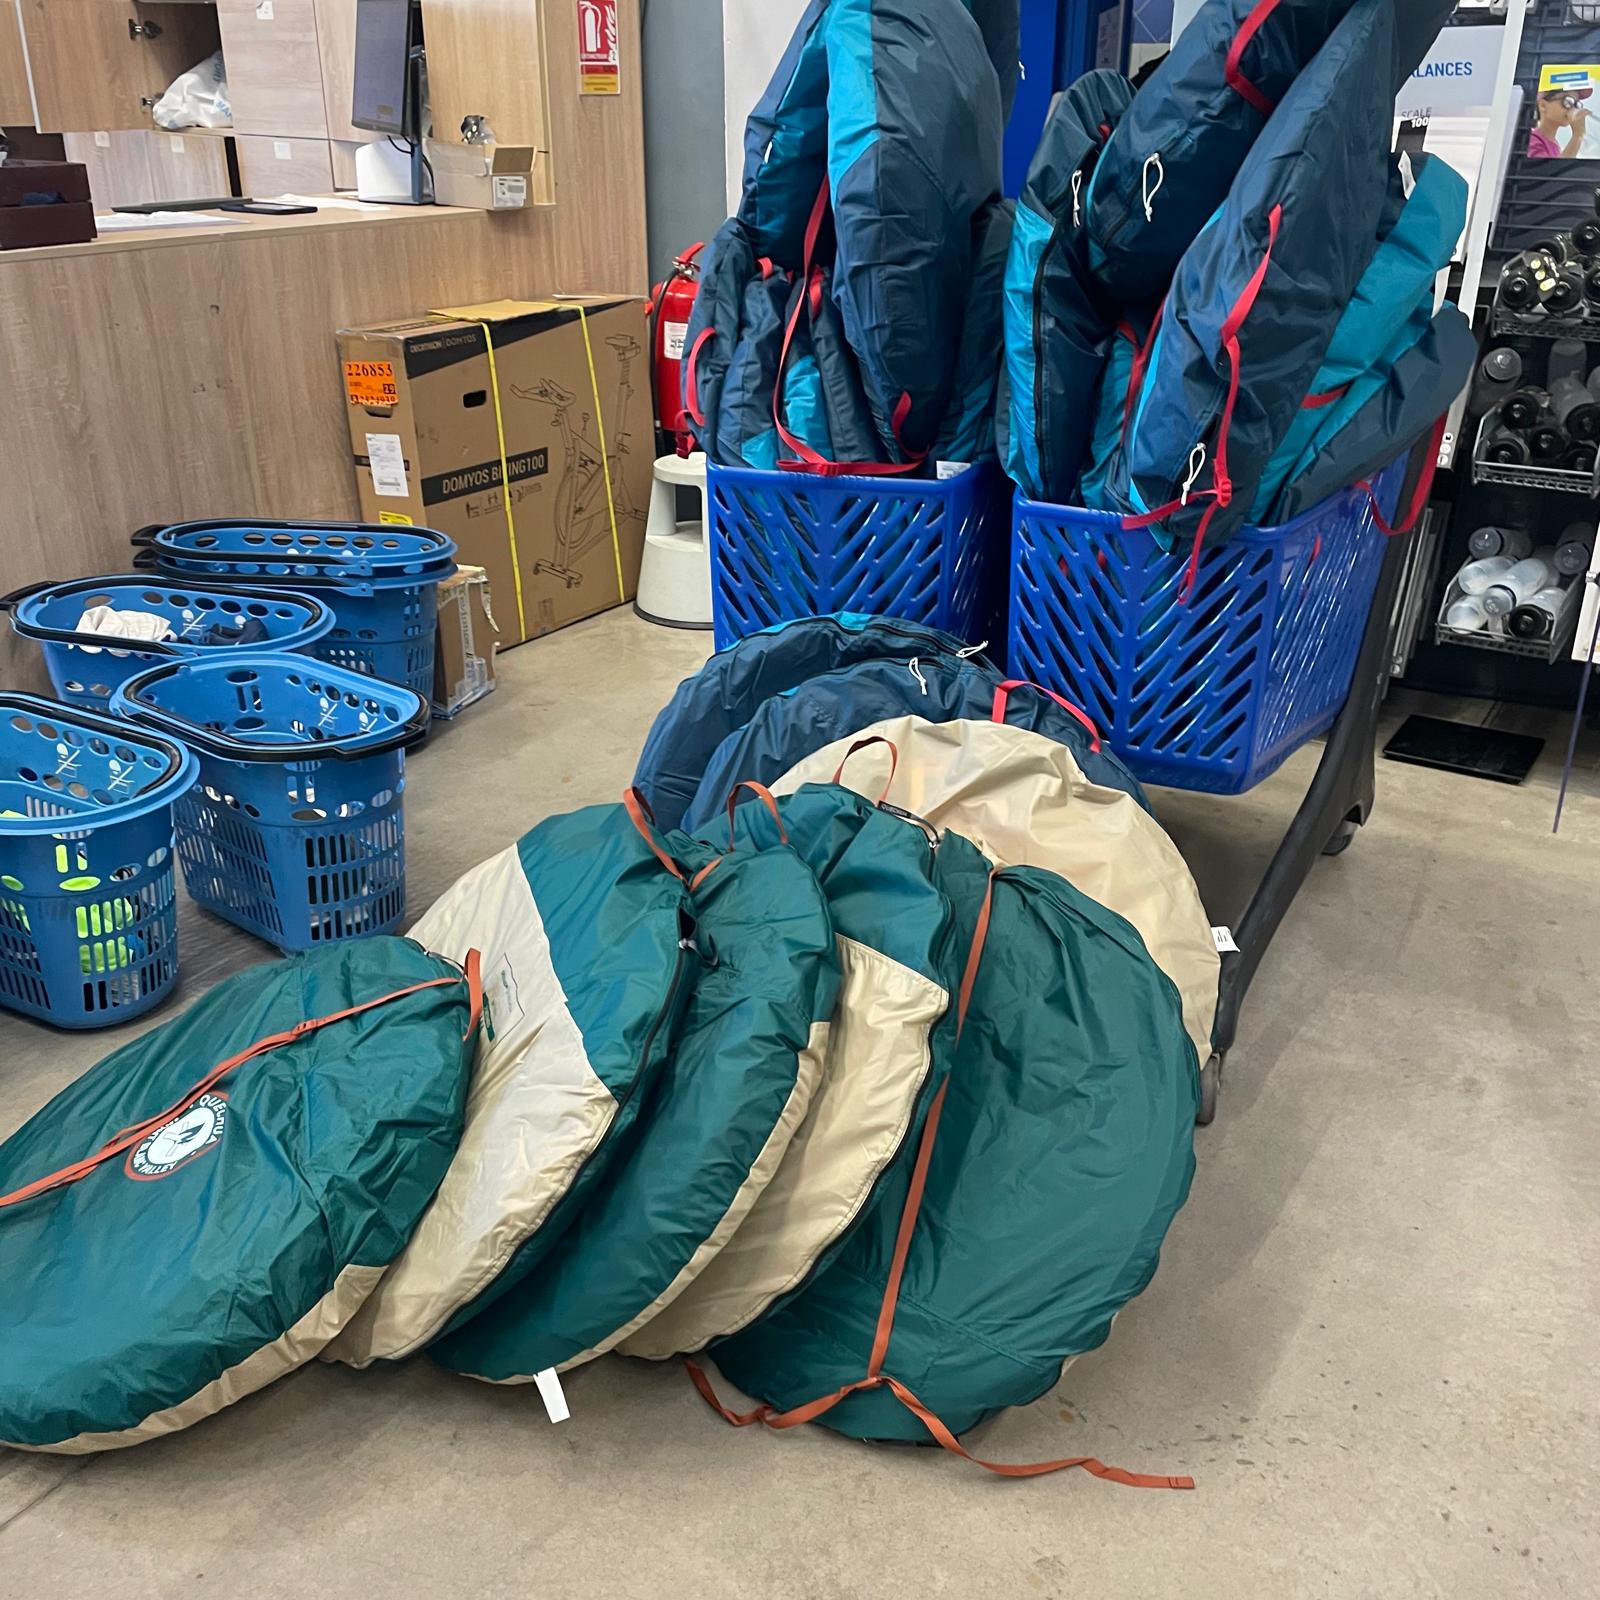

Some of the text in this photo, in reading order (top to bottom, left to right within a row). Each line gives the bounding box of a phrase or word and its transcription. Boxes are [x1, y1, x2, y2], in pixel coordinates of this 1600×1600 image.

[1411, 117, 1429, 128] 100
[346, 363, 393, 377] 226853
[443, 454, 545, 494] DOMYOS BIING100
